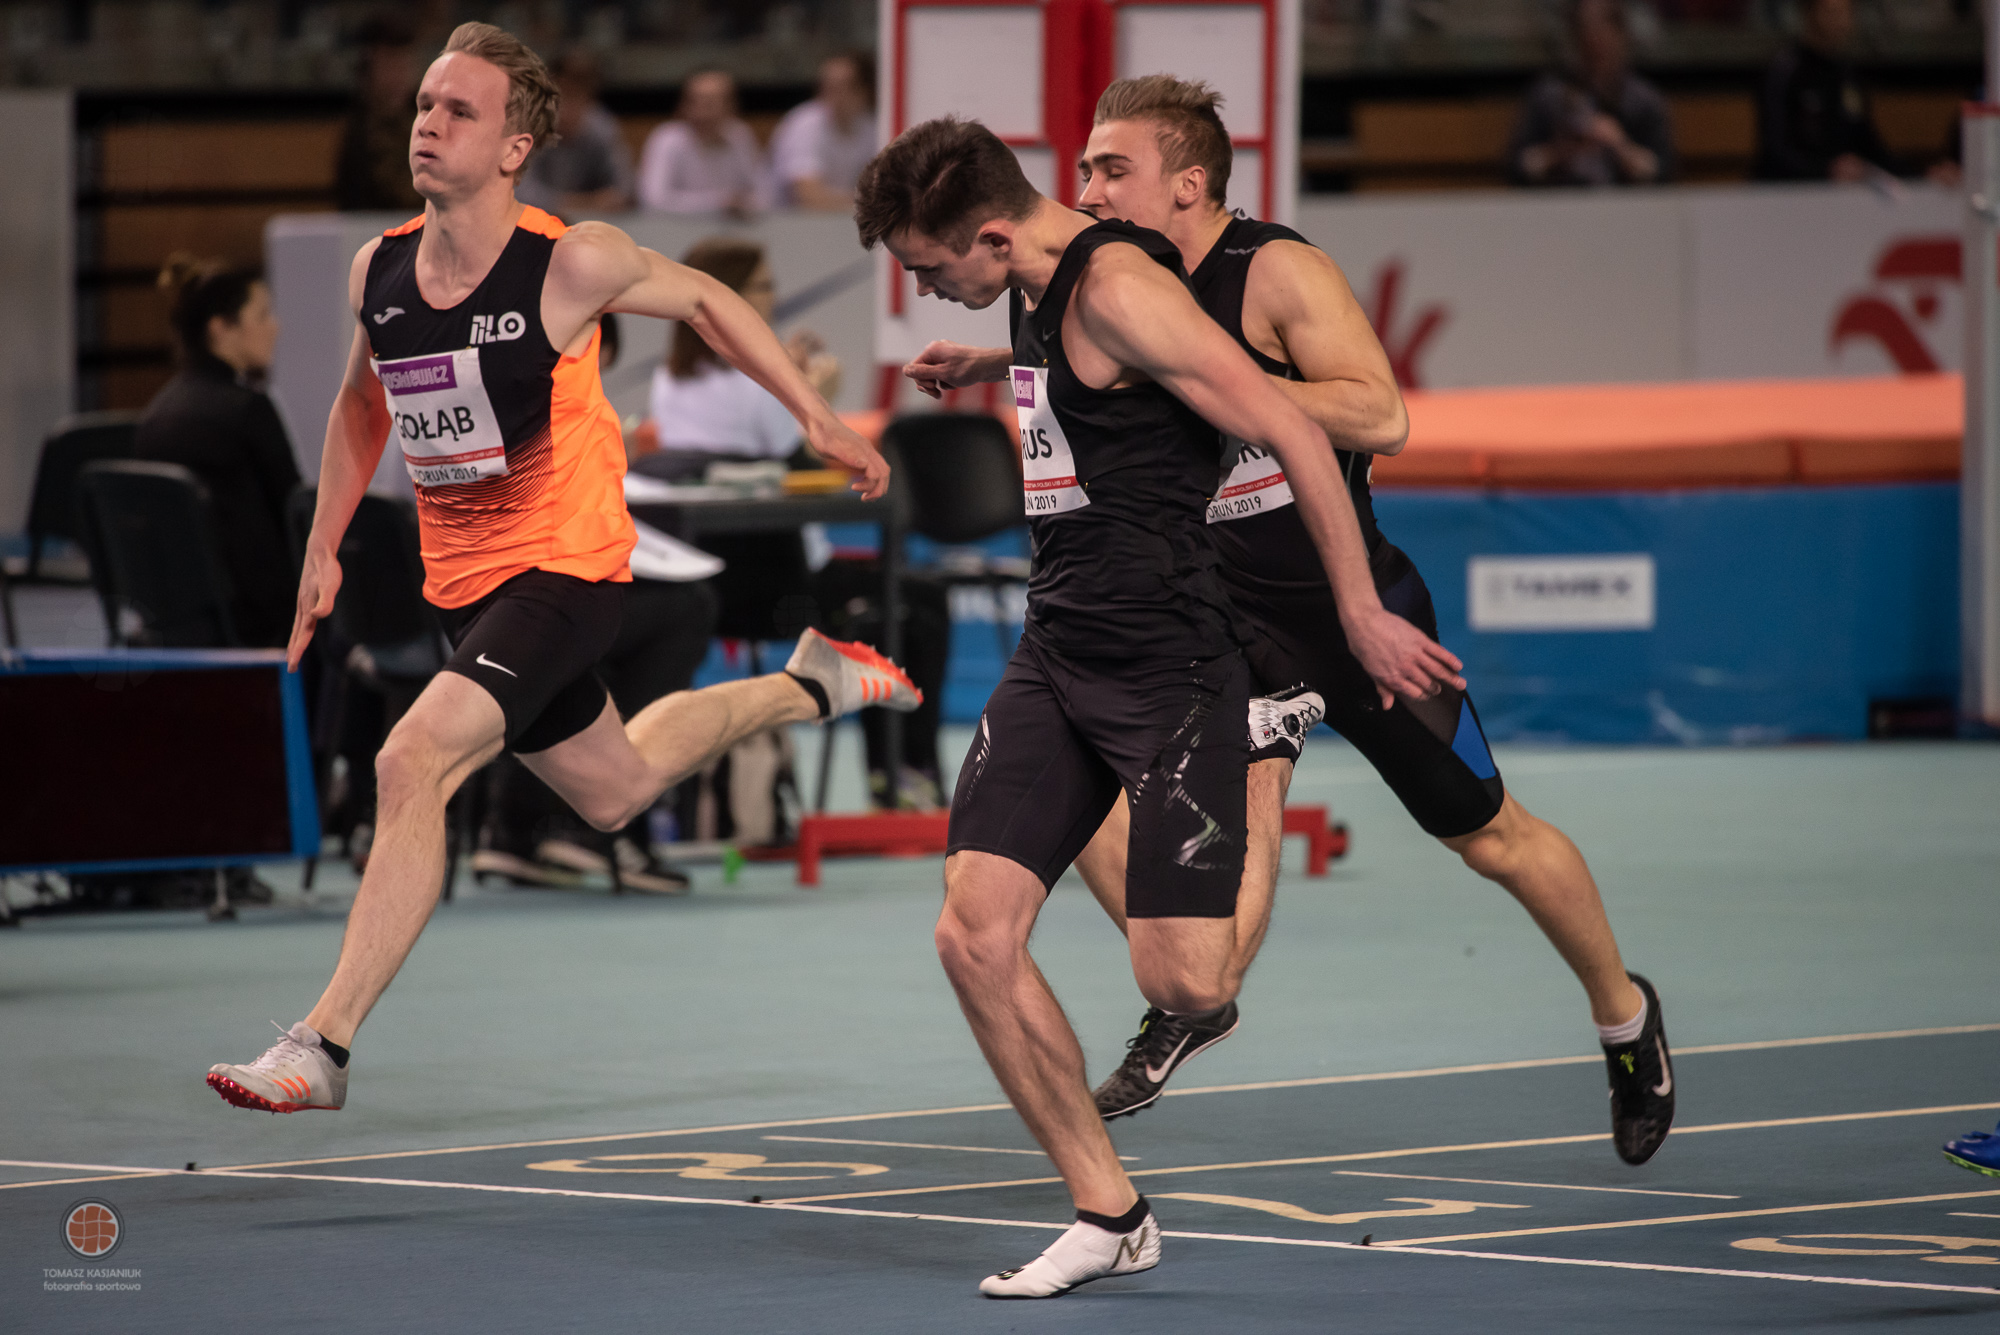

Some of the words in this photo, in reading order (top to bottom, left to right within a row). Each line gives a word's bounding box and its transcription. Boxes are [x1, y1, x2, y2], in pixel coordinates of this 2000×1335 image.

[395, 406, 475, 442] GOŁĄB
[451, 467, 478, 481] 2019
[1035, 495, 1057, 510] 2019
[1234, 495, 1262, 514] 2019
